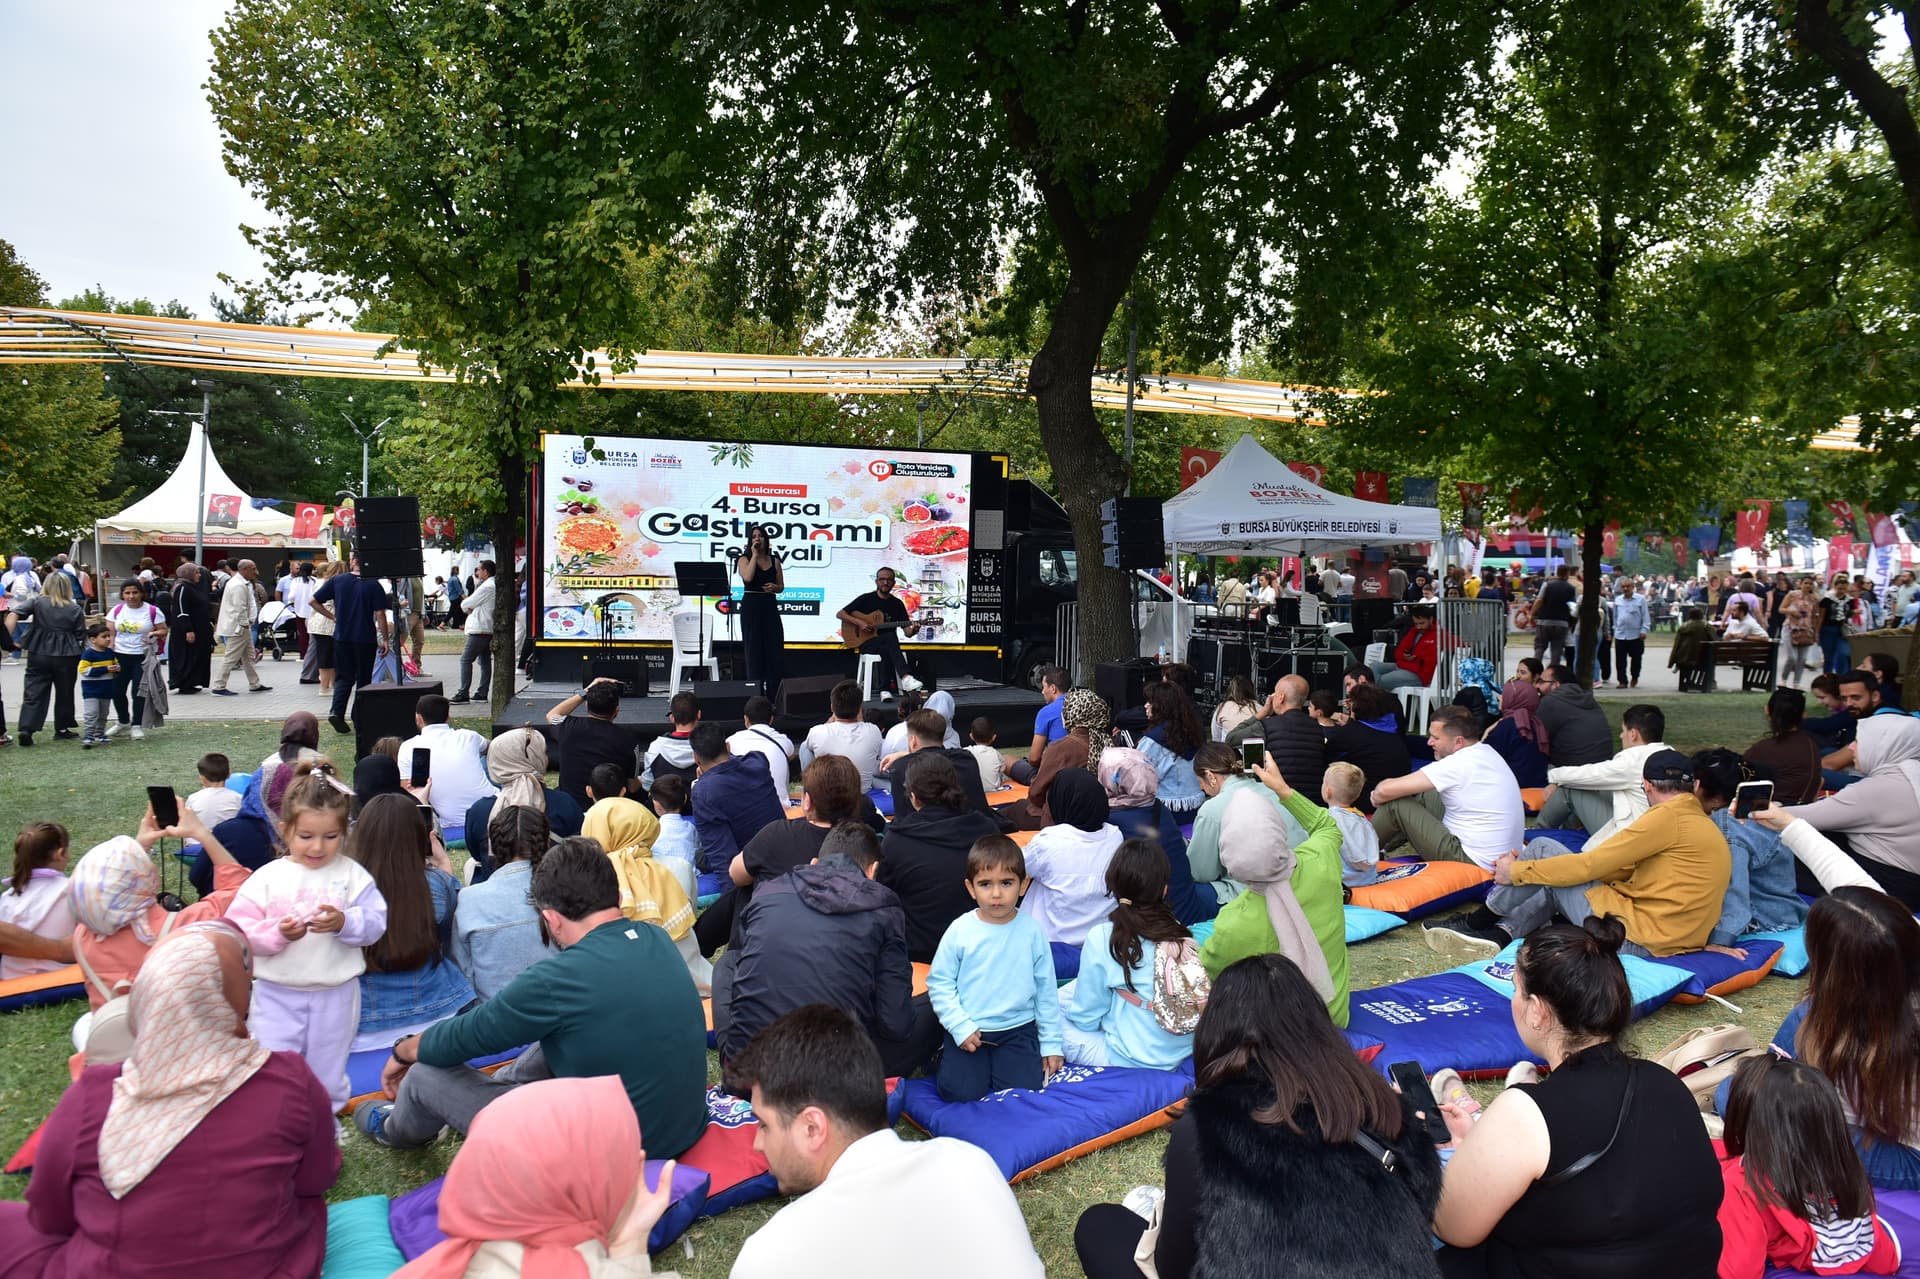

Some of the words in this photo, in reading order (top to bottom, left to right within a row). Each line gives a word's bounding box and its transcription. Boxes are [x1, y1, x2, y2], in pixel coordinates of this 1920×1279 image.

[895, 469, 949, 478] Oluşturuluyor
[737, 485, 801, 496] Uluslararası
[1249, 490, 1323, 500] BOZBEY
[711, 496, 737, 514] 4.
[743, 497, 820, 516] Bursa
[1239, 521, 1270, 533] BURSA
[1272, 519, 1329, 535] BÜYÜKŞEHİR
[1331, 520, 1381, 533] BELEDİYESİ
[784, 603, 813, 611] Parkı
[970, 612, 1001, 622] BURSA
[970, 623, 1001, 633] KÜLTÜR
[648, 660, 665, 668] ÜLTÜR
